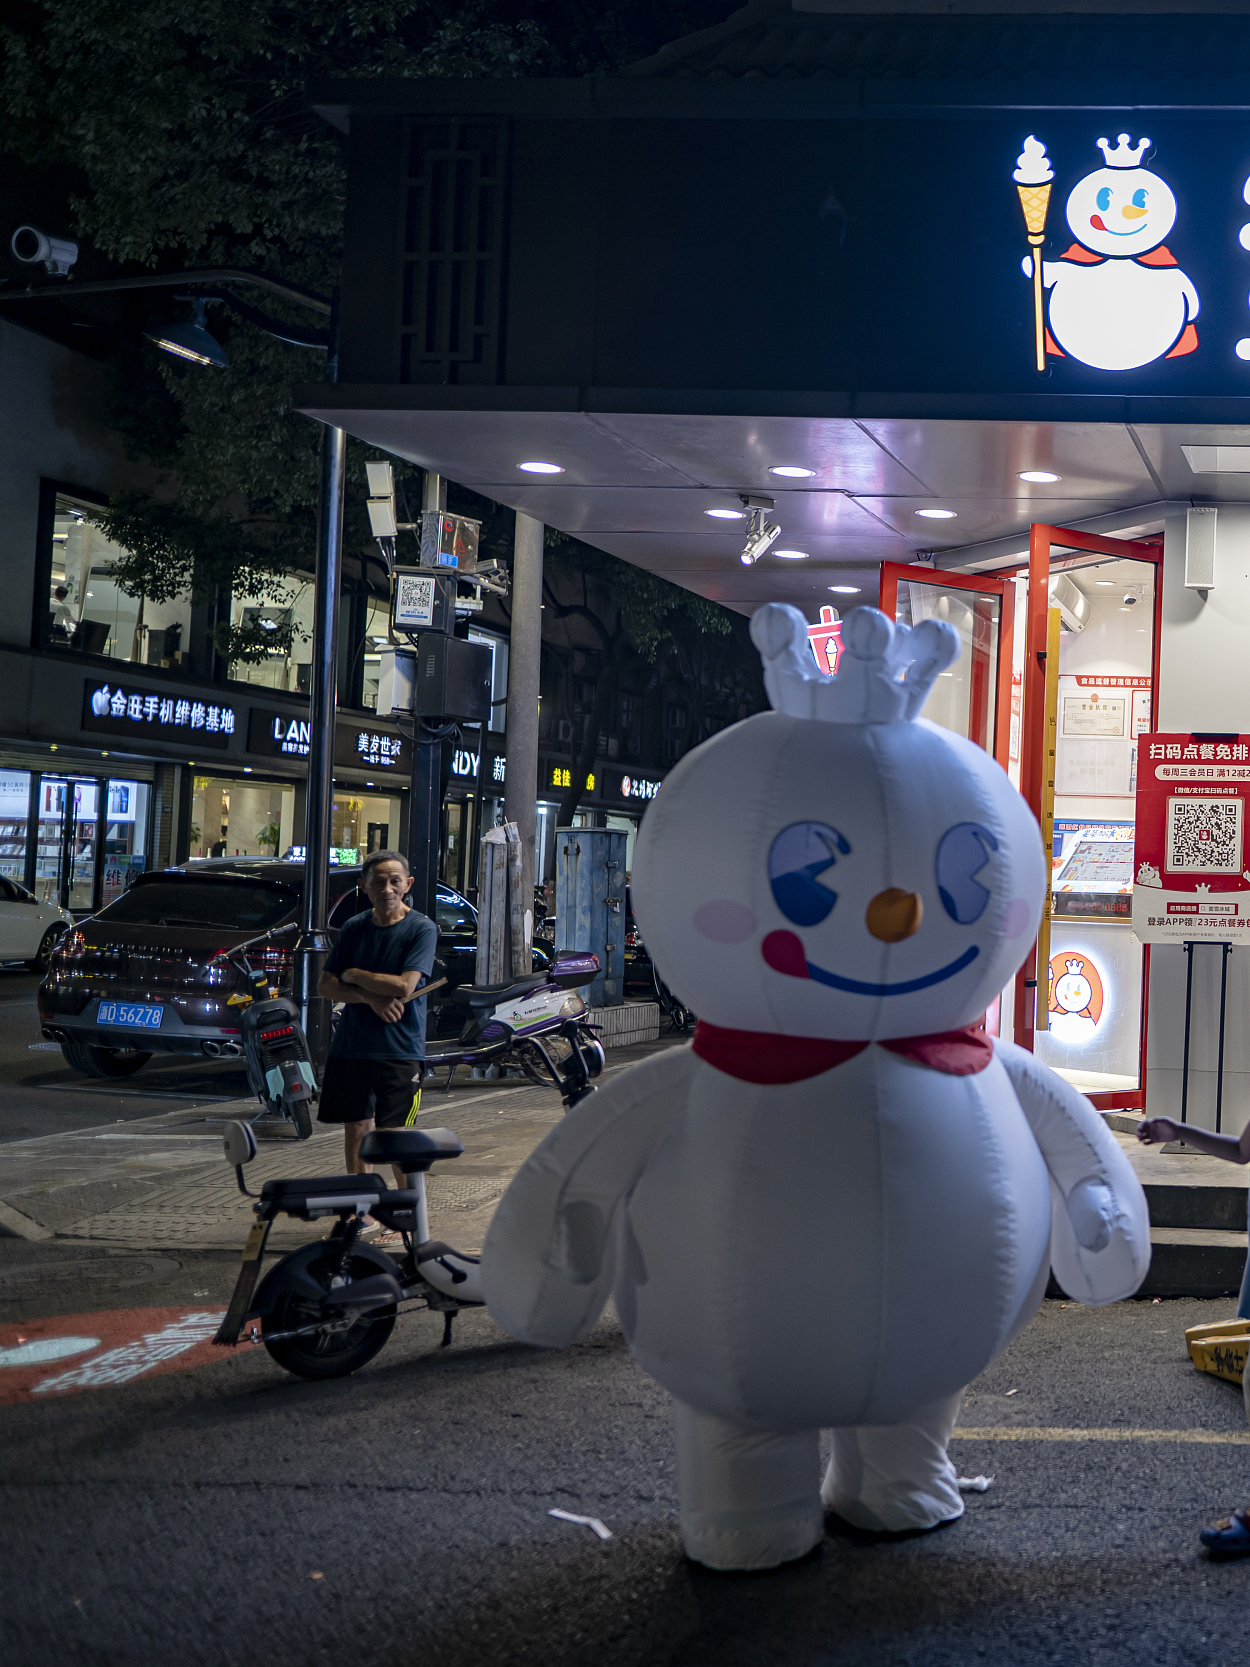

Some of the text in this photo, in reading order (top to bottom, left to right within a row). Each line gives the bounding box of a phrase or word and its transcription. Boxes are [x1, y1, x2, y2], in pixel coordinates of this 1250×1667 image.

[110, 687, 236, 735] 金旺手机维修基地
[357, 731, 402, 757] 美发世家
[1162, 768, 1214, 777] 每周三会员日
